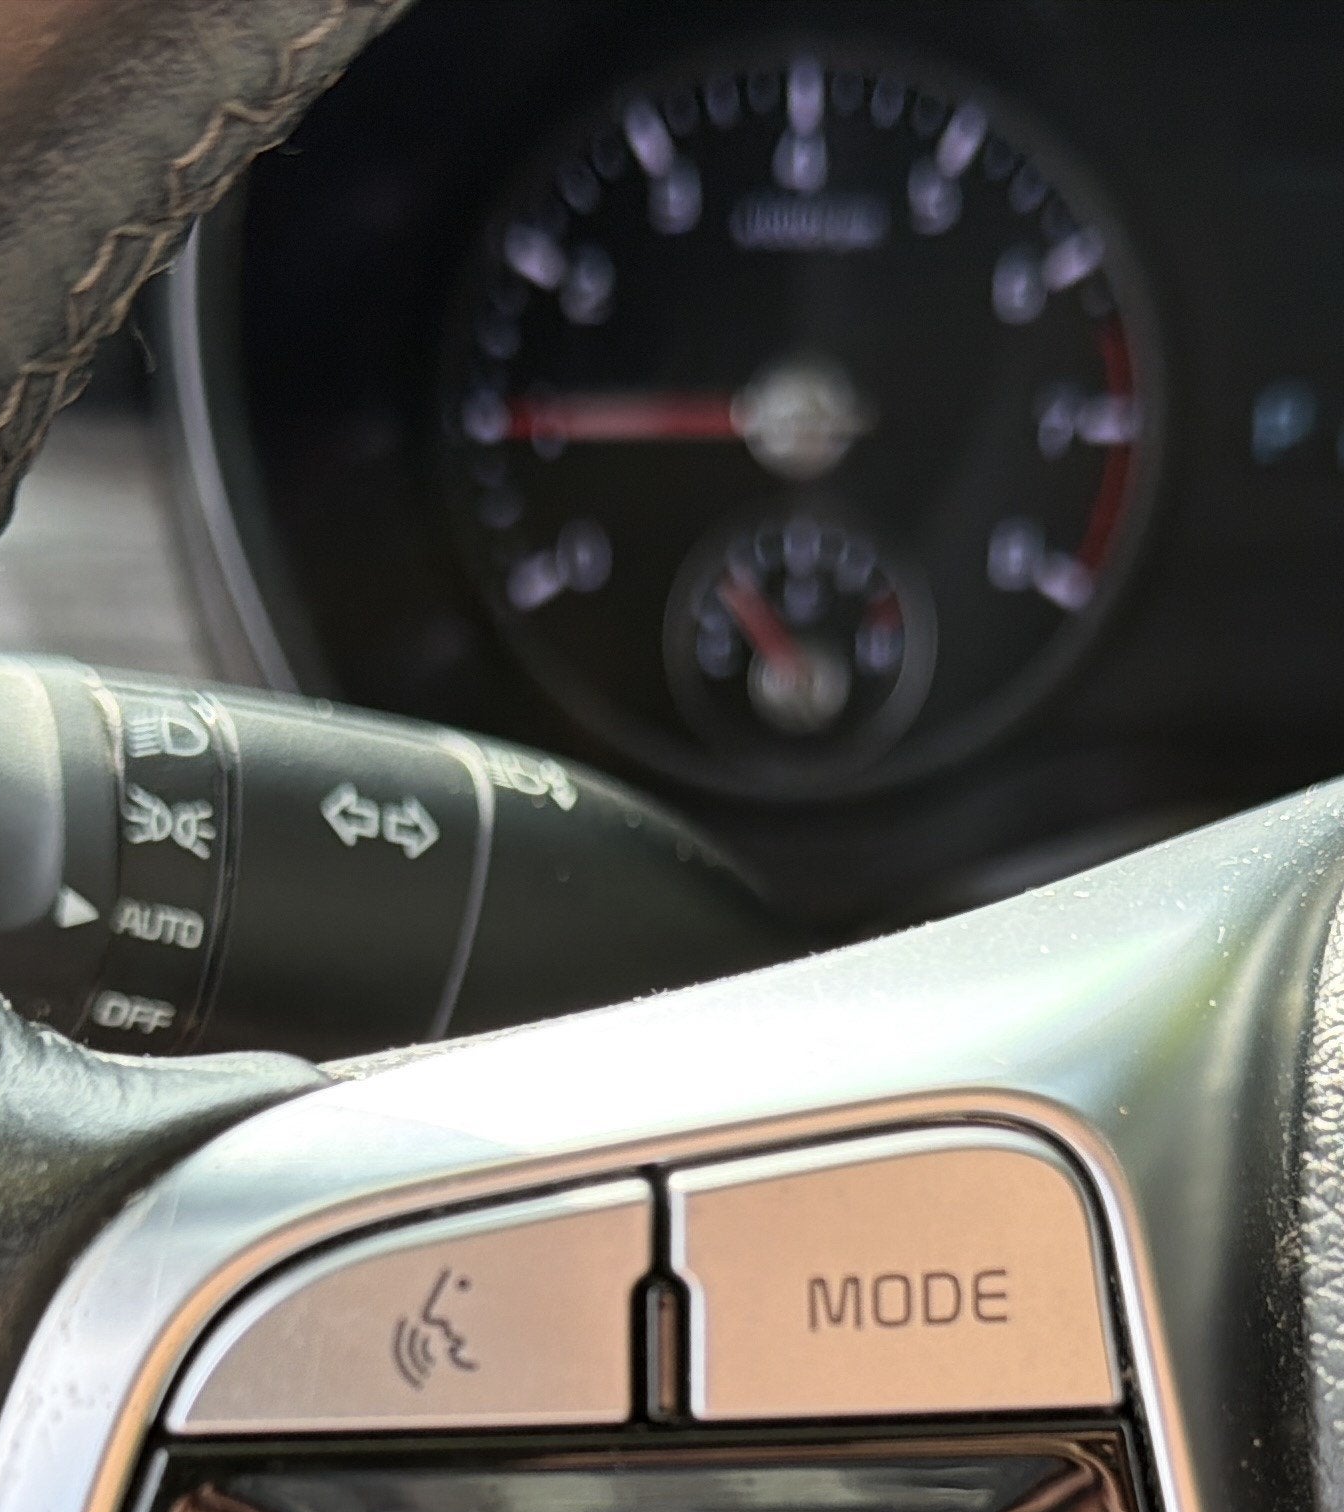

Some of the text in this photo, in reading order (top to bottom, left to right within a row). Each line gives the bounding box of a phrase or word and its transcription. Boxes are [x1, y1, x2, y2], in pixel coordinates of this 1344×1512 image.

[112, 898, 204, 949] AUTO
[92, 990, 177, 1035] OFF
[808, 1268, 1008, 1331] MODE
